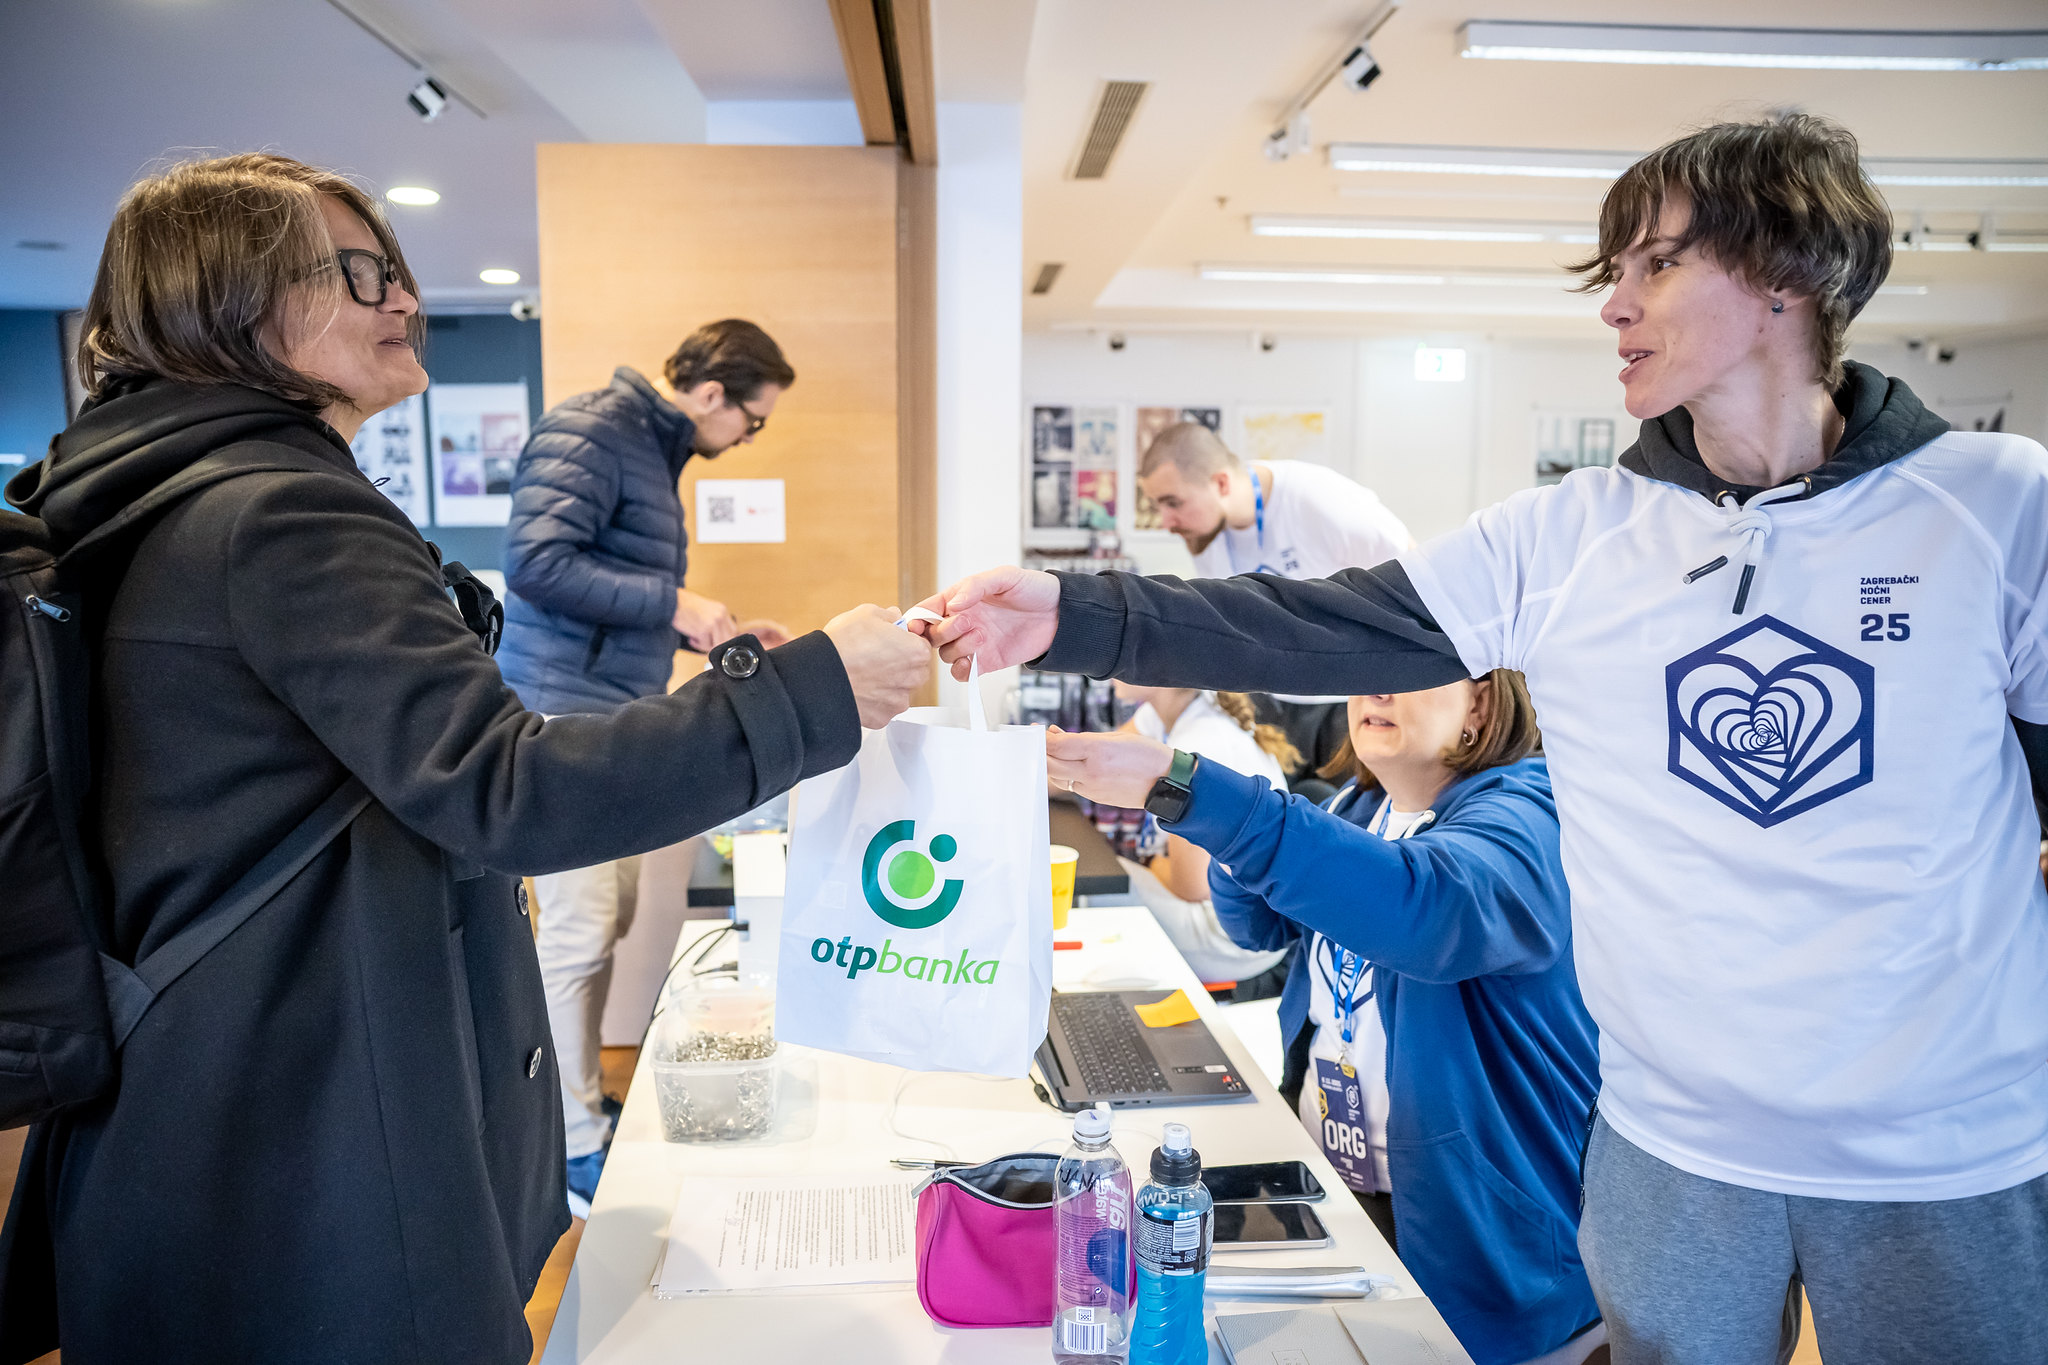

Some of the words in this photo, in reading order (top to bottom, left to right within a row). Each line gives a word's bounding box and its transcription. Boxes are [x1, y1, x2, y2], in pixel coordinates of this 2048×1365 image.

[1860, 575, 1919, 585] ZAGREBAČKI
[1860, 596, 1891, 604] CENER
[1860, 613, 1911, 642] 25
[810, 935, 1000, 985] otpbanka
[1324, 1118, 1367, 1160] ORG
